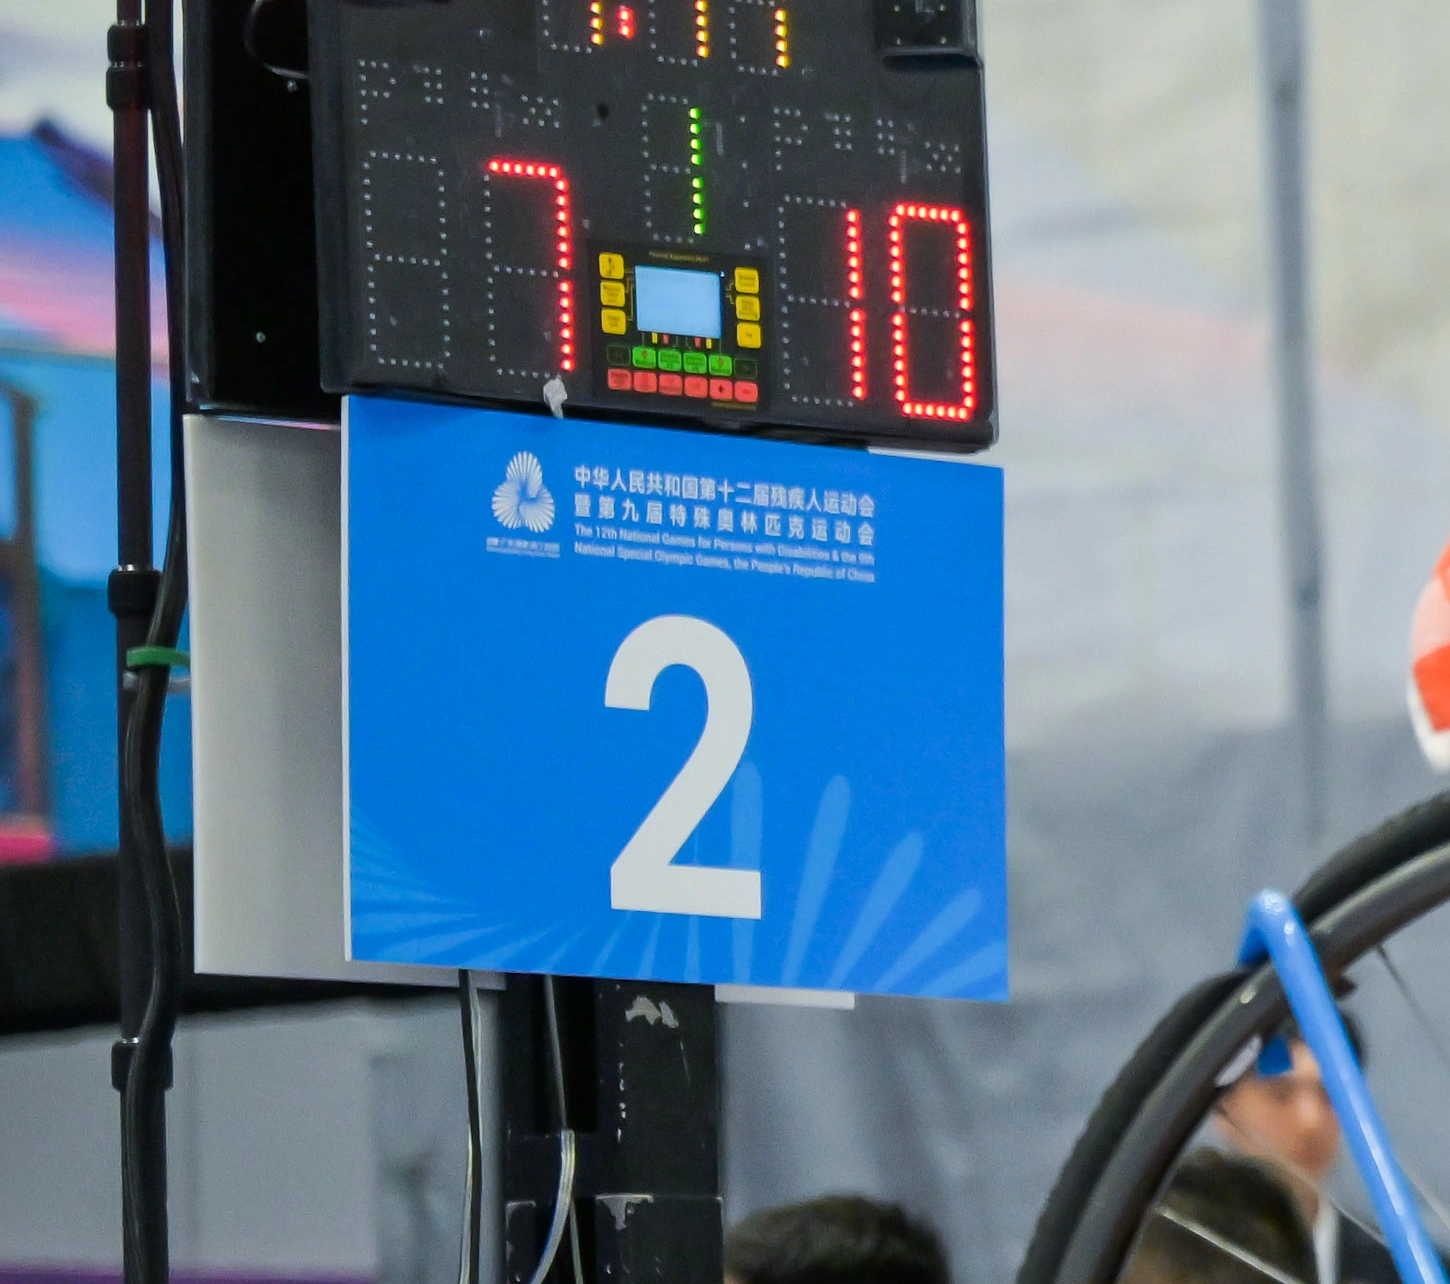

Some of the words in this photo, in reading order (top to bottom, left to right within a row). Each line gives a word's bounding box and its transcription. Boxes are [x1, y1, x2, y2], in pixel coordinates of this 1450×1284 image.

[688, 106, 707, 235] 1
[489, 160, 576, 373] 7
[846, 203, 974, 421] 10
[574, 464, 875, 518] 中华人民共和国第十二届残疾人运动会
[574, 492, 875, 546] 暨第九届特殊奥林匹克运动会
[575, 523, 594, 537] The
[595, 526, 618, 540] 12th
[619, 528, 660, 544] National
[662, 533, 696, 548] Games
[574, 541, 615, 557] National
[604, 613, 762, 920] 2
